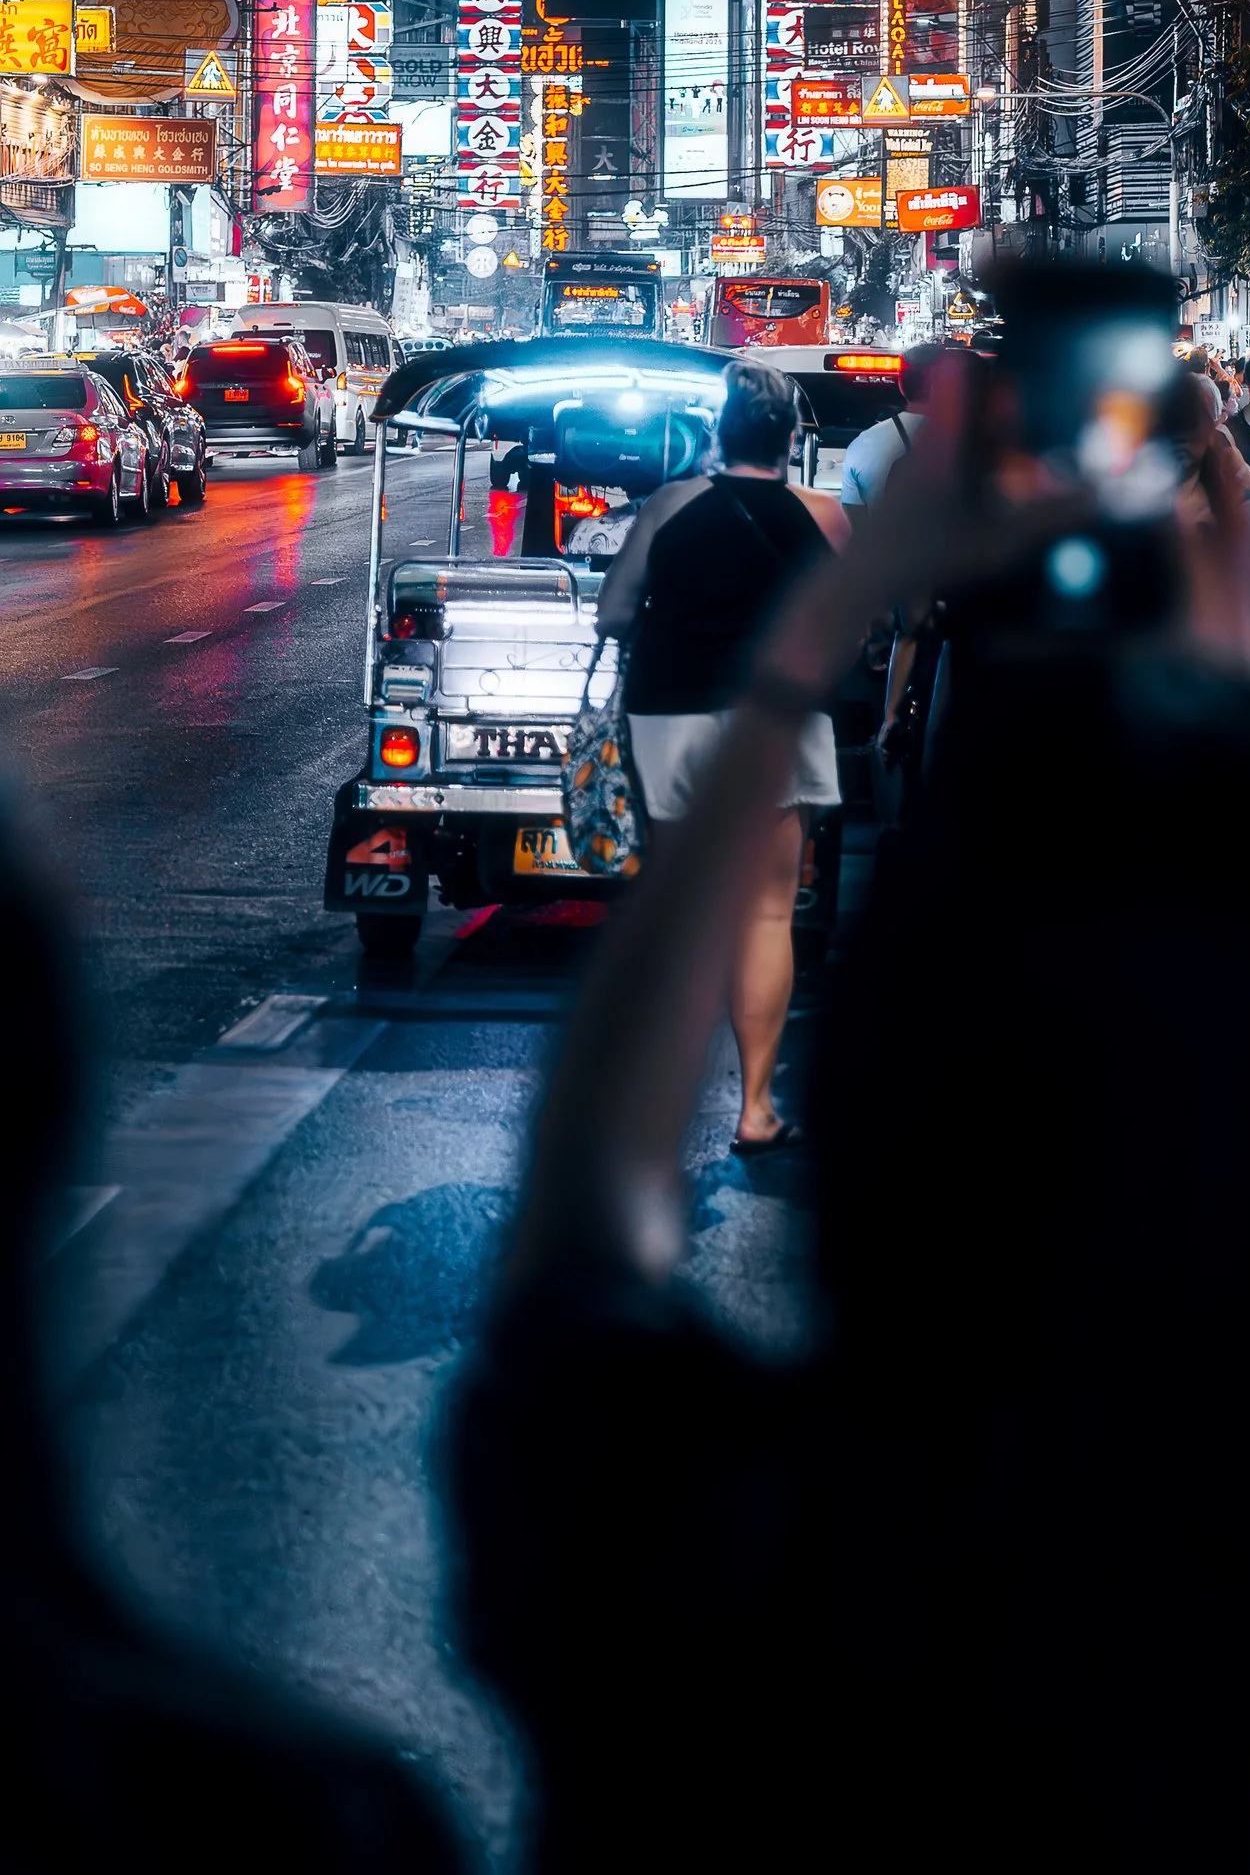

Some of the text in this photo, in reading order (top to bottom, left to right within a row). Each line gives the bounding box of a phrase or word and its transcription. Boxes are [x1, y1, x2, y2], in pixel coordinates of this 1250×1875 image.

[807, 41, 848, 56] Hotel
[270, 4, 301, 192] 北京同仁堂
[89, 163, 208, 175] SO SENG HENG GOLDSMITH
[922, 213, 955, 227] Coca-Cola
[344, 875, 411, 897] WD
